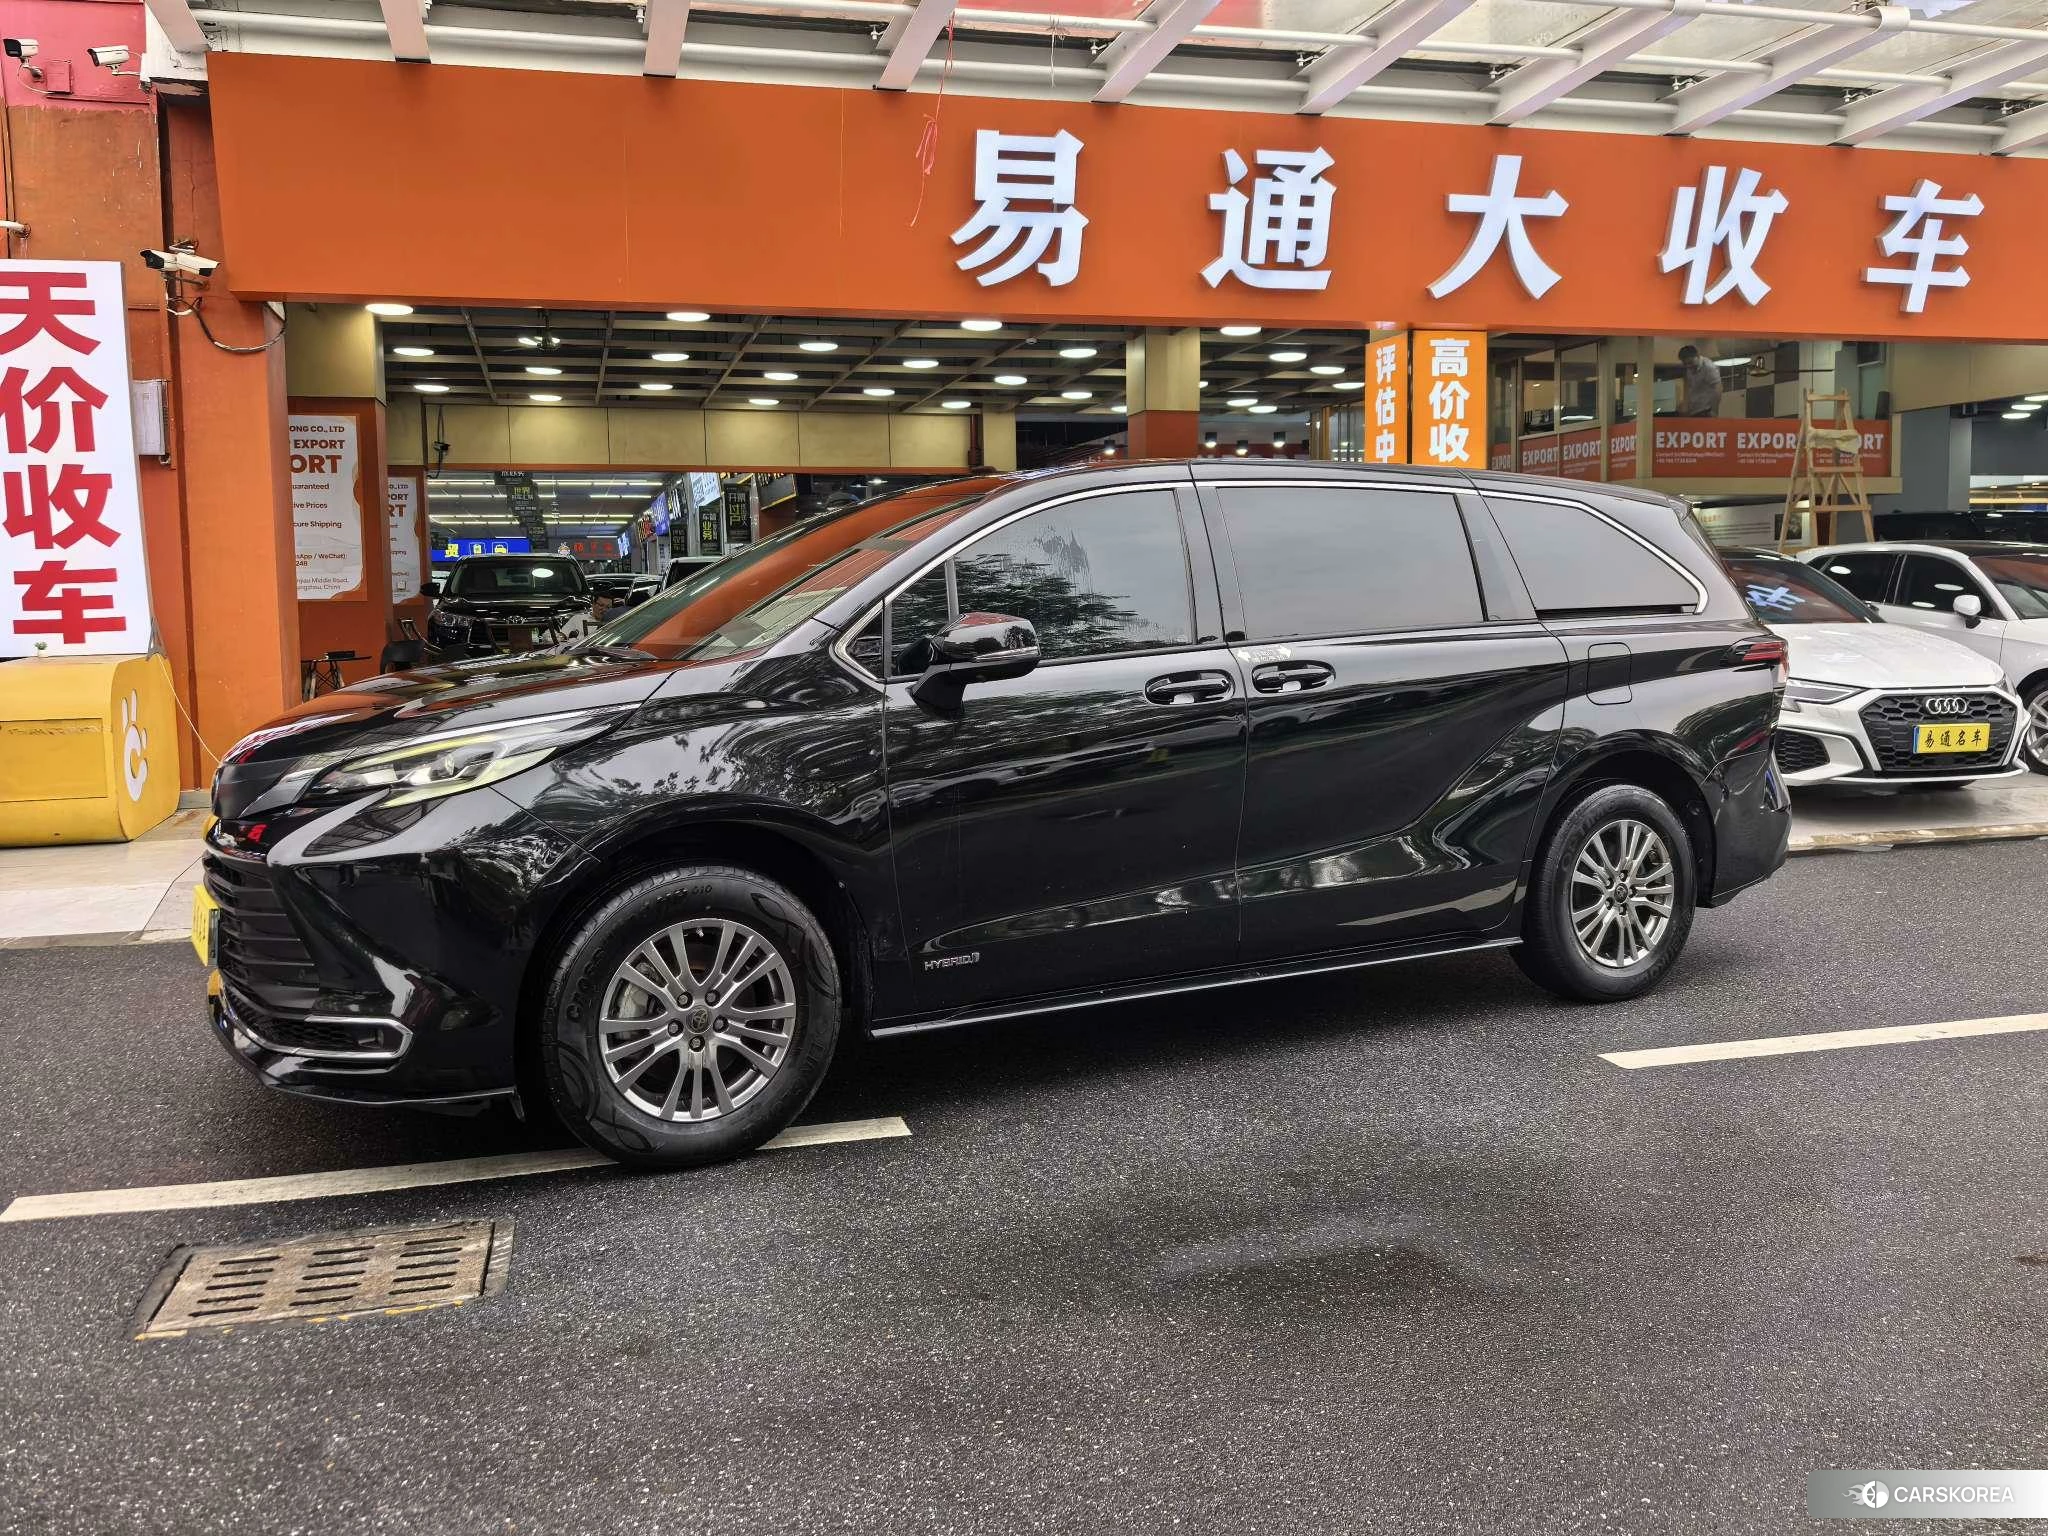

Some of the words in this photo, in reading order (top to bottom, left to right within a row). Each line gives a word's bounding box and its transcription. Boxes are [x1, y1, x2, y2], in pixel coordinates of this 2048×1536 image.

[949, 128, 1985, 314] 易通大收车
[1375, 344, 1396, 463] 评估中
[1429, 338, 1470, 463] 高价收
[294, 439, 346, 449] EXPORT
[1656, 431, 1727, 449] EXPORT
[1737, 432, 1797, 449] EXPOR
[0, 271, 126, 644] 天价收车
[290, 454, 342, 474] ORT
[1491, 455, 1511, 470] EXPOR
[306, 501, 328, 509] Prices
[388, 493, 409, 501] ORT
[310, 520, 343, 529] Shipping
[1924, 728, 1982, 749] 易通名车
[924, 955, 972, 971] HYBRID
